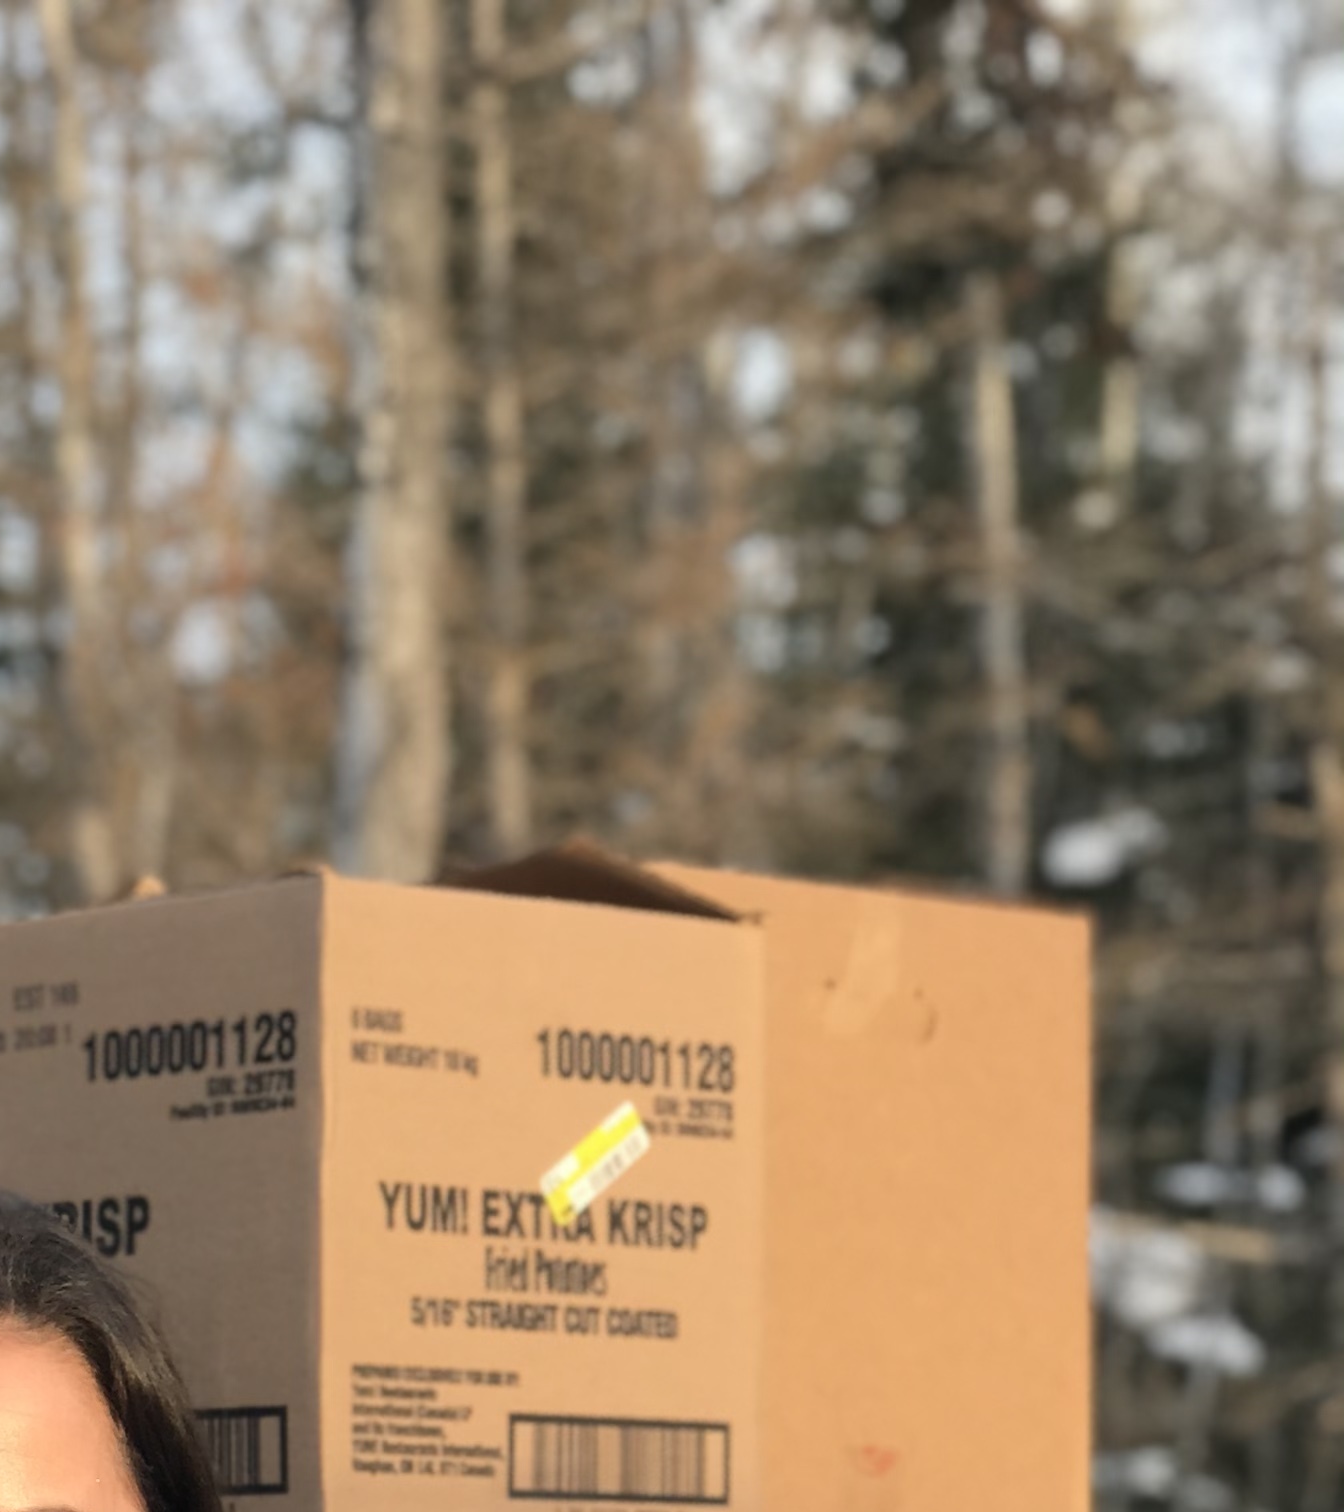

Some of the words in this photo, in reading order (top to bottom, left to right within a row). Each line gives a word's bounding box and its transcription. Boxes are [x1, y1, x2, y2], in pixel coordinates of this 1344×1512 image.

[83, 1009, 297, 1082] 1000001128
[536, 1027, 735, 1093] 1000001128
[379, 1180, 469, 1235] YUM!
[608, 1200, 708, 1251] KRISP
[465, 1300, 558, 1334] STRAIGHT
[565, 1305, 600, 1337] CUT
[607, 1308, 679, 1340] COATED
